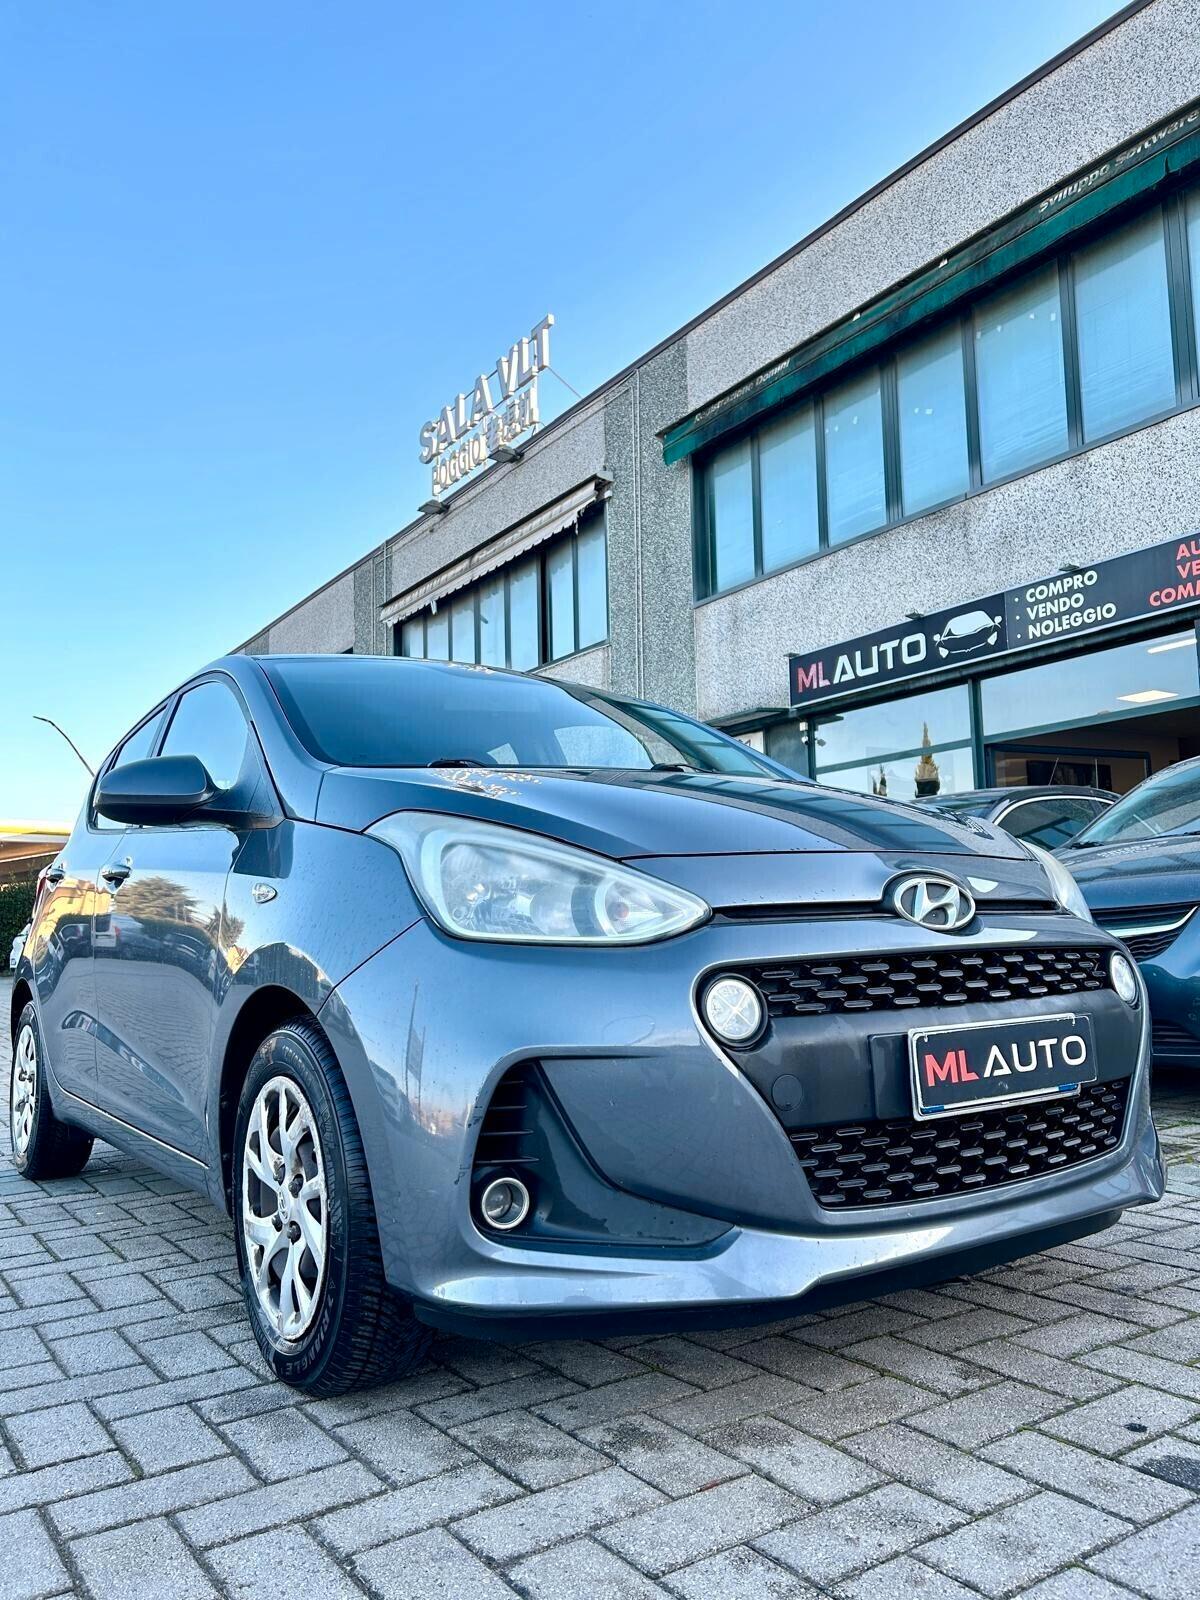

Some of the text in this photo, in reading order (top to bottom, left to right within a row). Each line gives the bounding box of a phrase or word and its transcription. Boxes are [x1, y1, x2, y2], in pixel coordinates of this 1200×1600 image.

[1038, 109, 1200, 213] Sviluppo Software
[419, 374, 495, 464] SALA
[496, 313, 555, 401] VLT
[432, 432, 488, 496] POGGIO
[1025, 570, 1098, 603] COMPRO
[1026, 593, 1085, 621] VENDO
[1027, 602, 1117, 640] NOLEGGIO
[832, 632, 926, 684] AUTO
[924, 1035, 1087, 1087] ML AUTO
[285, 1293, 335, 1376] TRIANGLE
